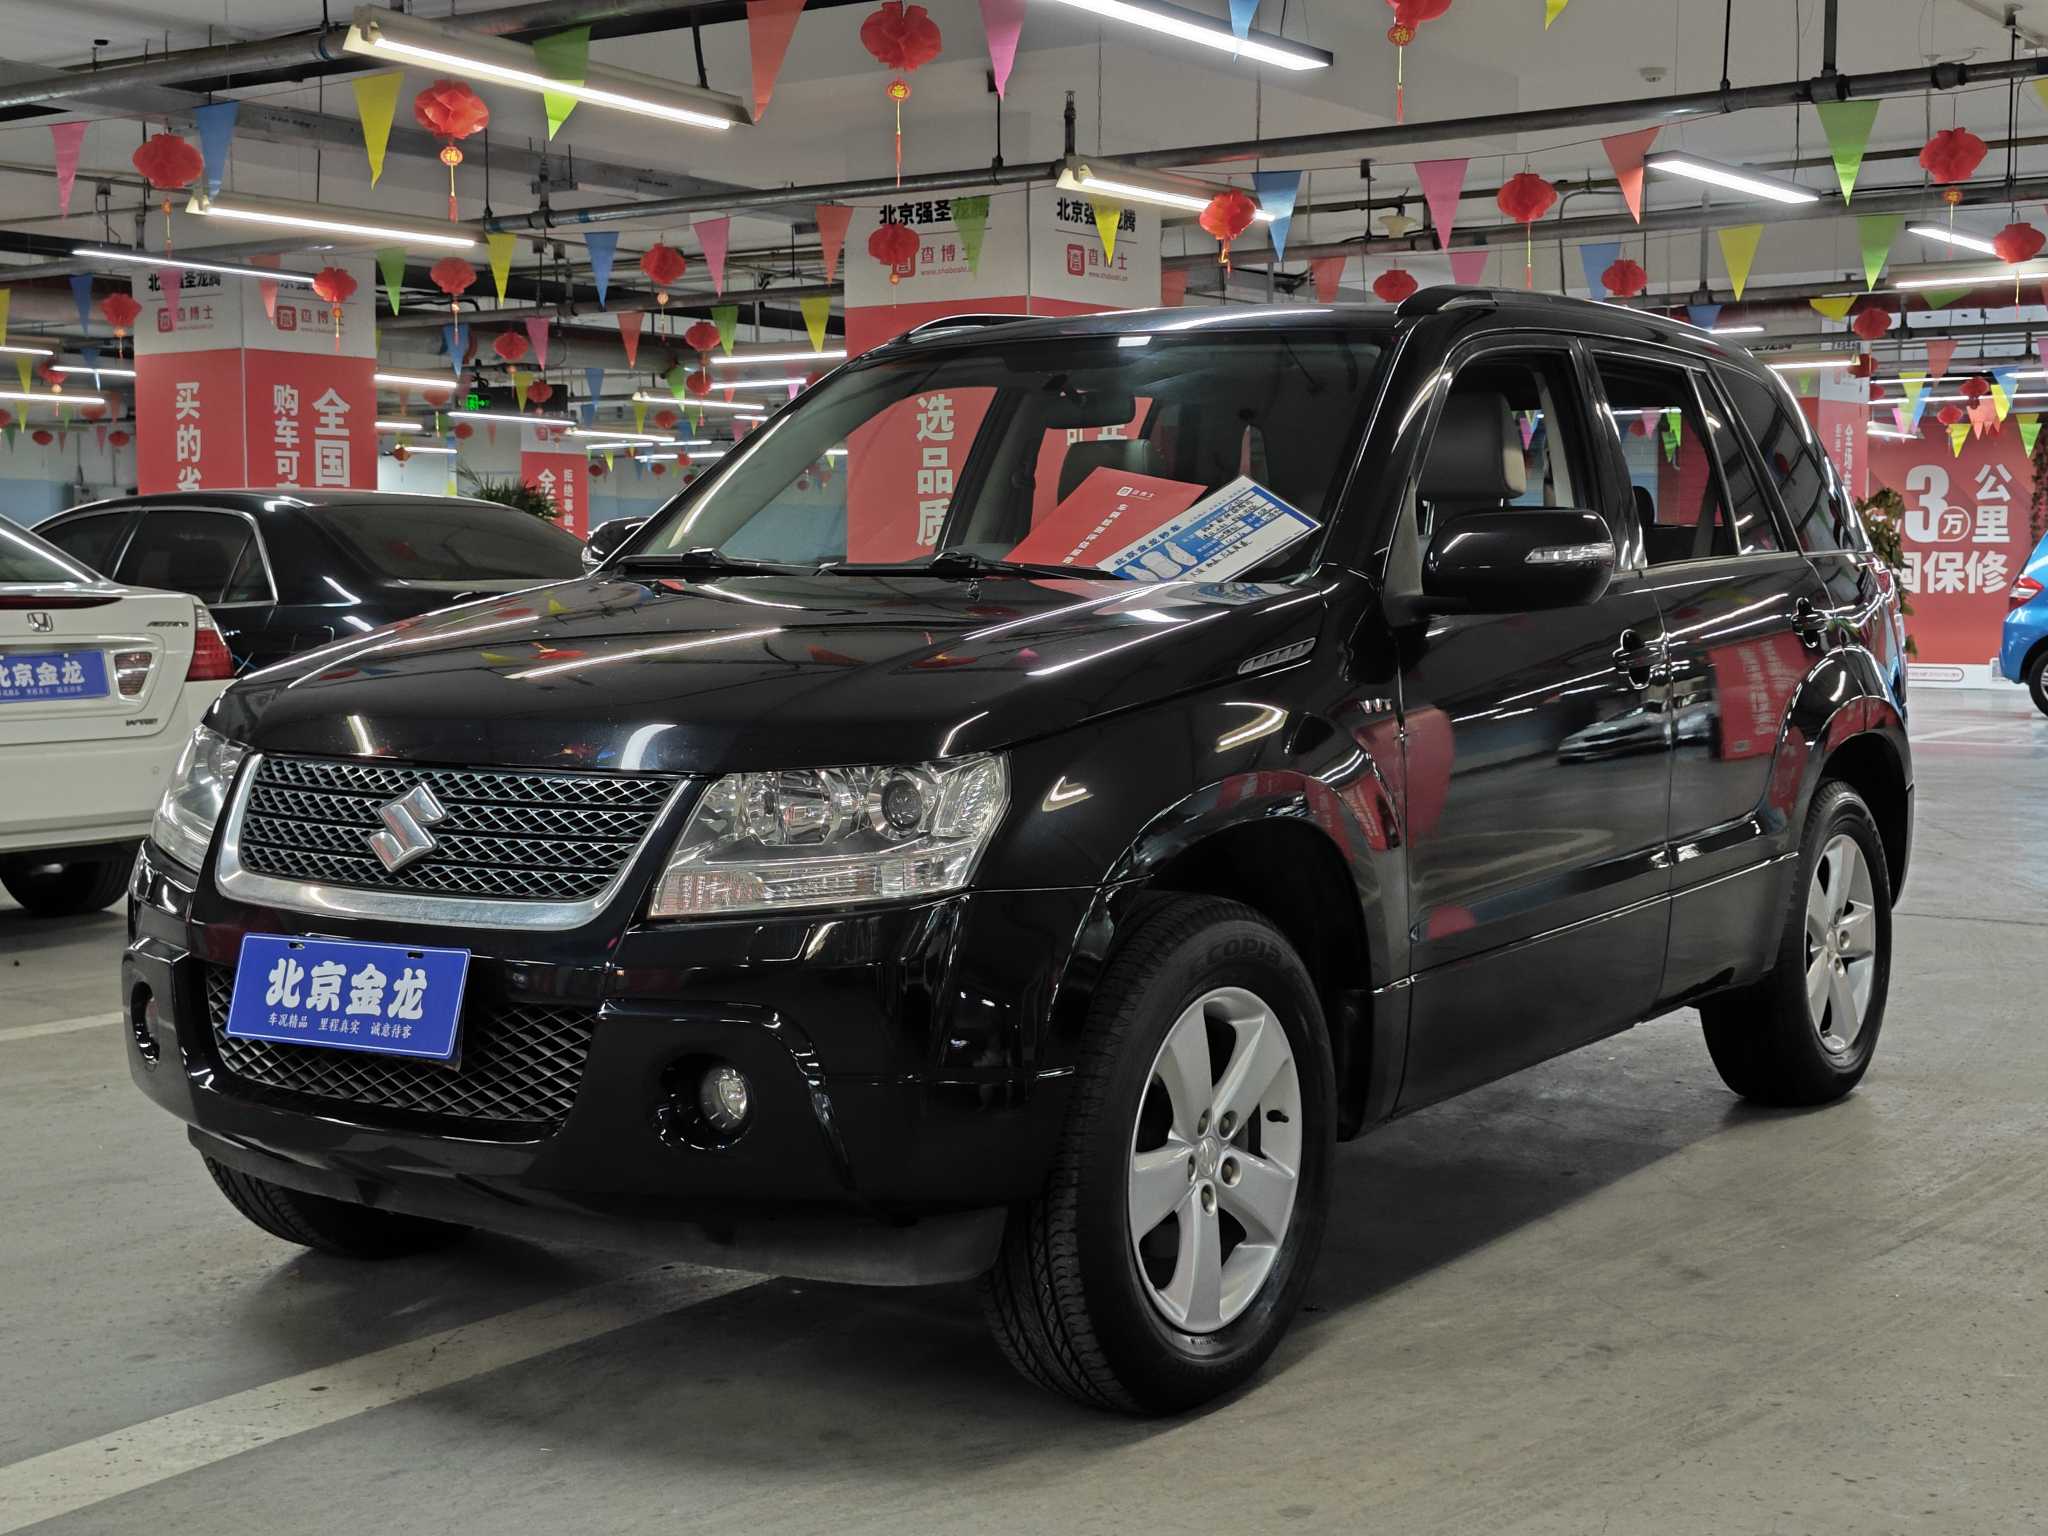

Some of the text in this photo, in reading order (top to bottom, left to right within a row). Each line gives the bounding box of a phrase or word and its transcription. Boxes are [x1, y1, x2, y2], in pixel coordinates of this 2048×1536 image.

[1056, 197, 1136, 232] 北京强腾
[148, 271, 222, 292] 北圣龙腾
[1088, 247, 1128, 271] 查士
[273, 384, 300, 489] 购车可
[312, 387, 351, 488] 全国
[916, 394, 954, 546] 选品质
[1905, 463, 2013, 543] 3万 公里
[265, 958, 428, 1020] 北京金龙
[267, 1011, 413, 1040] 车况精品 里程真实 诚意待客
